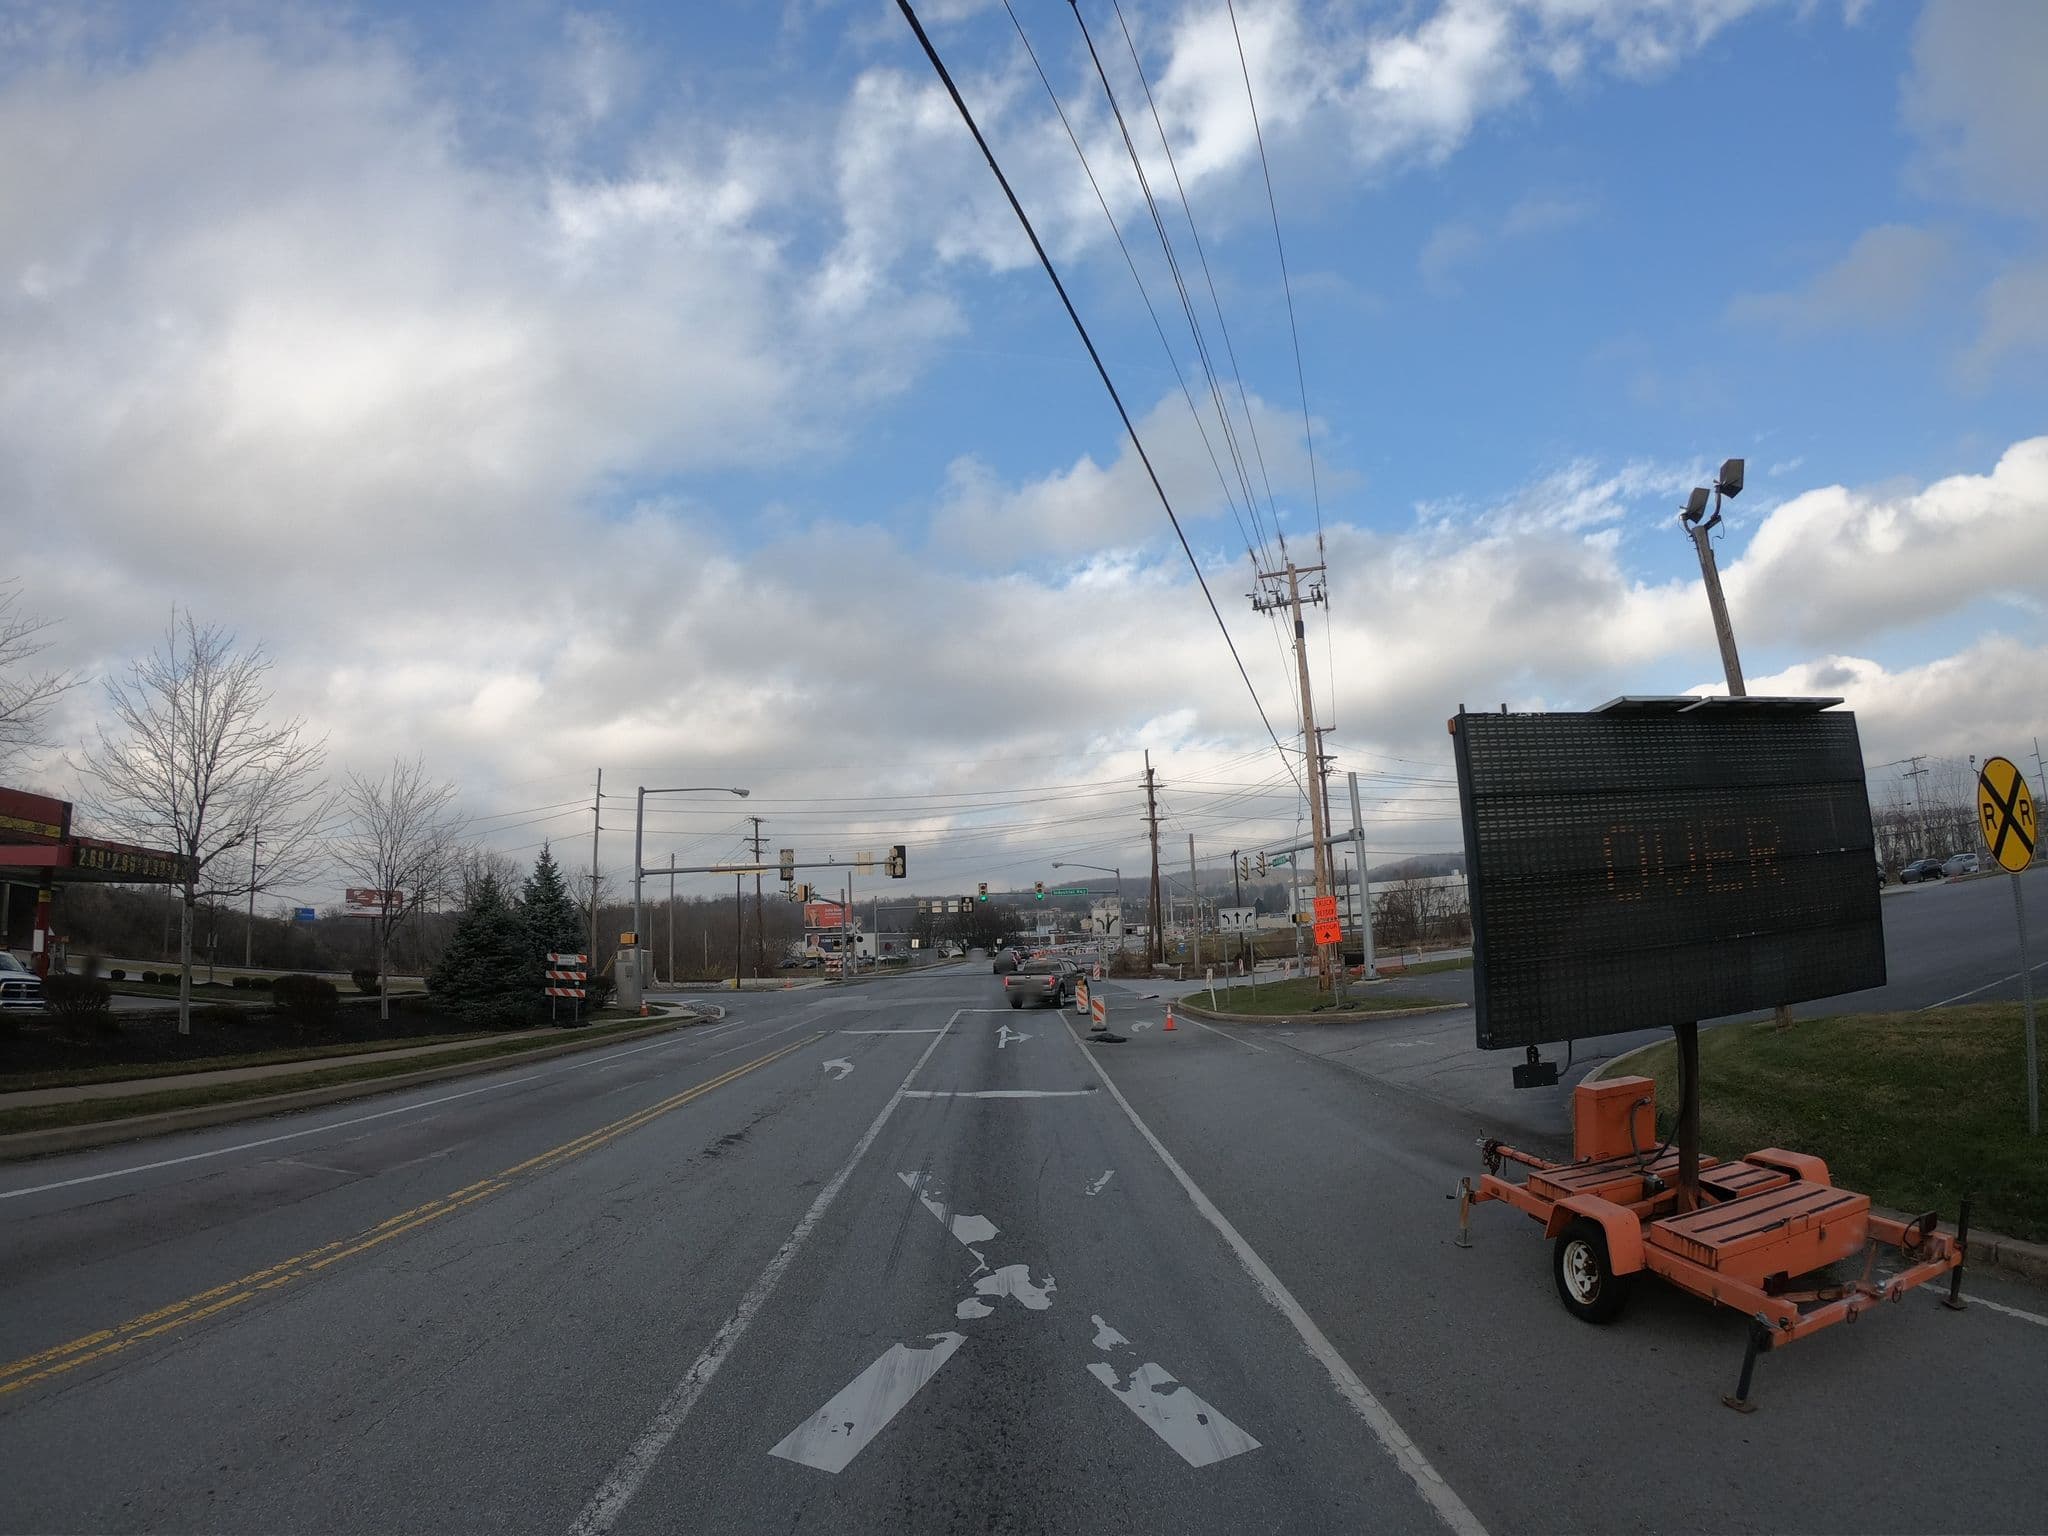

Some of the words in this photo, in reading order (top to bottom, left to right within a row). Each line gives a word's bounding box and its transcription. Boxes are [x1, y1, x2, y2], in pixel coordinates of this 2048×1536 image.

[1983, 802, 1998, 830] R
[2019, 799, 2032, 826] R
[1603, 816, 1786, 903] OVER
